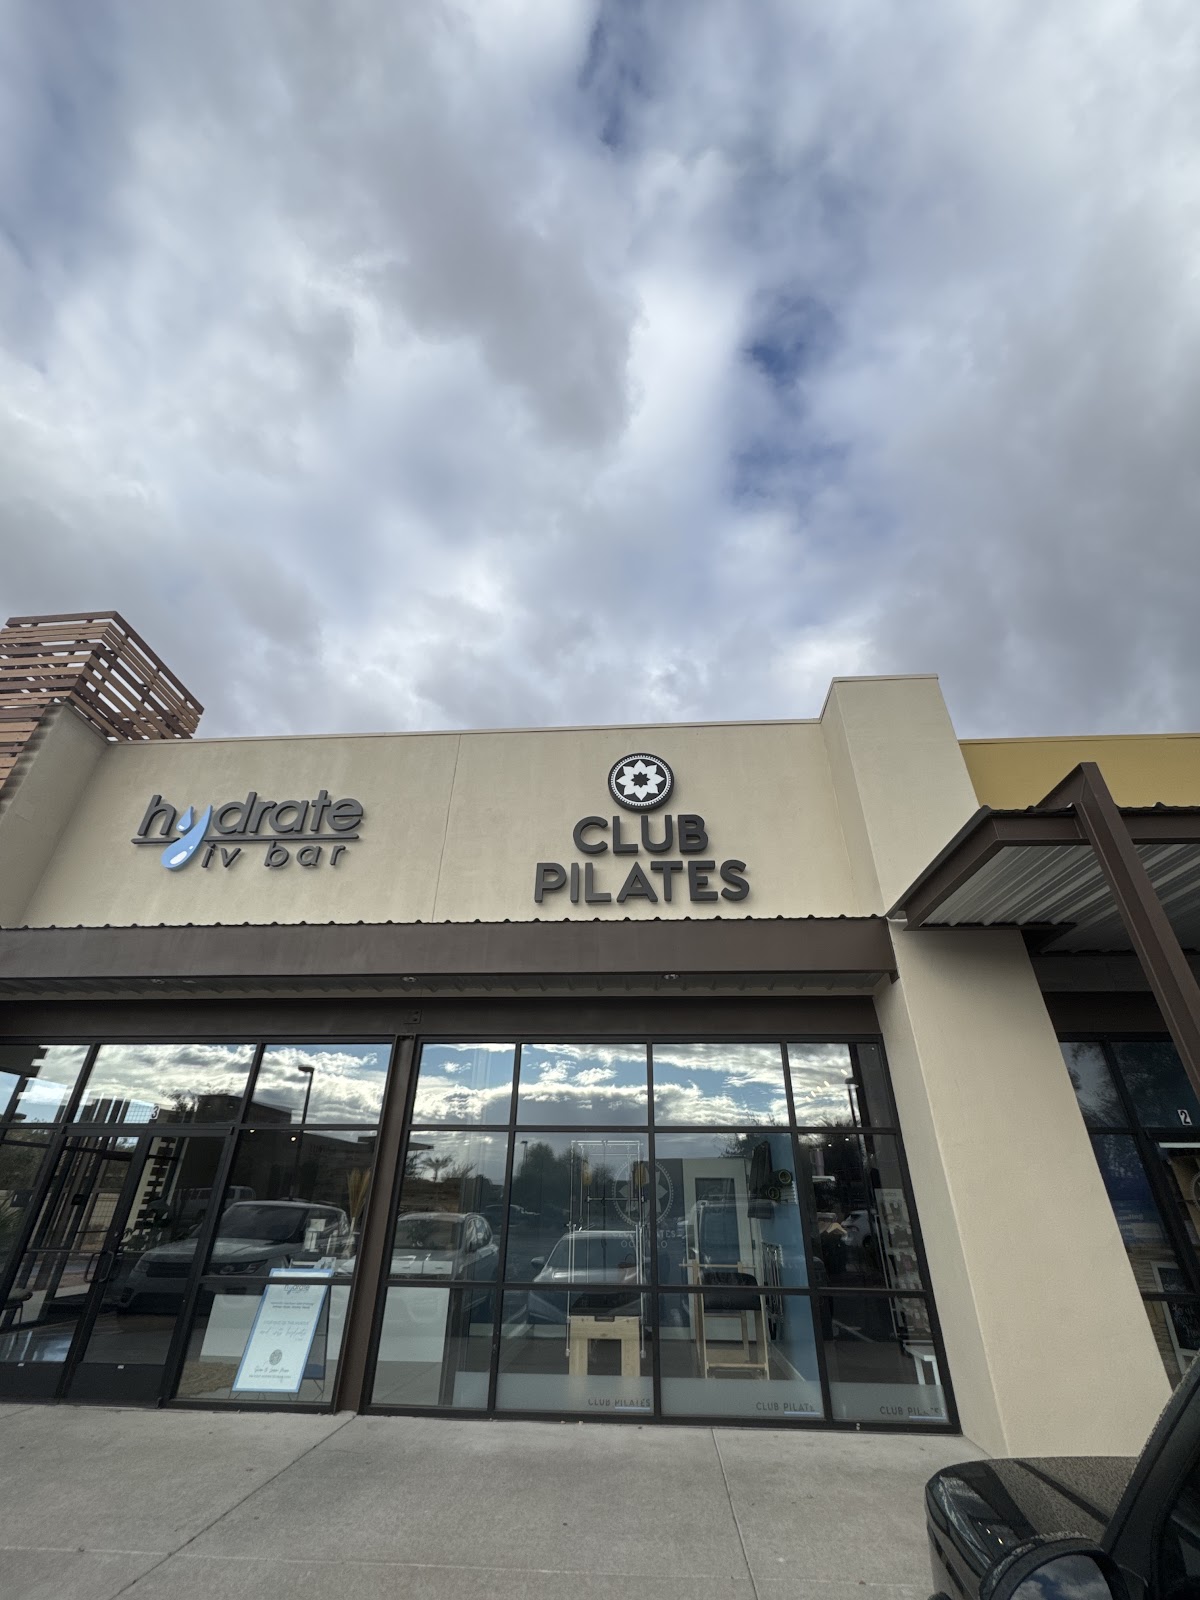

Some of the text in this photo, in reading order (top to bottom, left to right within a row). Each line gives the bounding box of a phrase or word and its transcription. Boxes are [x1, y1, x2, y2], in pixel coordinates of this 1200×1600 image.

[137, 789, 363, 870] hydrate
[573, 814, 709, 856] CLUB
[201, 840, 346, 868] iv bar
[534, 860, 750, 904] PILATES
[151, 1105, 160, 1119] 3
[1180, 1110, 1191, 1125] 2
[587, 1398, 611, 1407] CLUB
[755, 1401, 816, 1412] CLUB PILAT
[879, 1405, 904, 1416] CLUB
